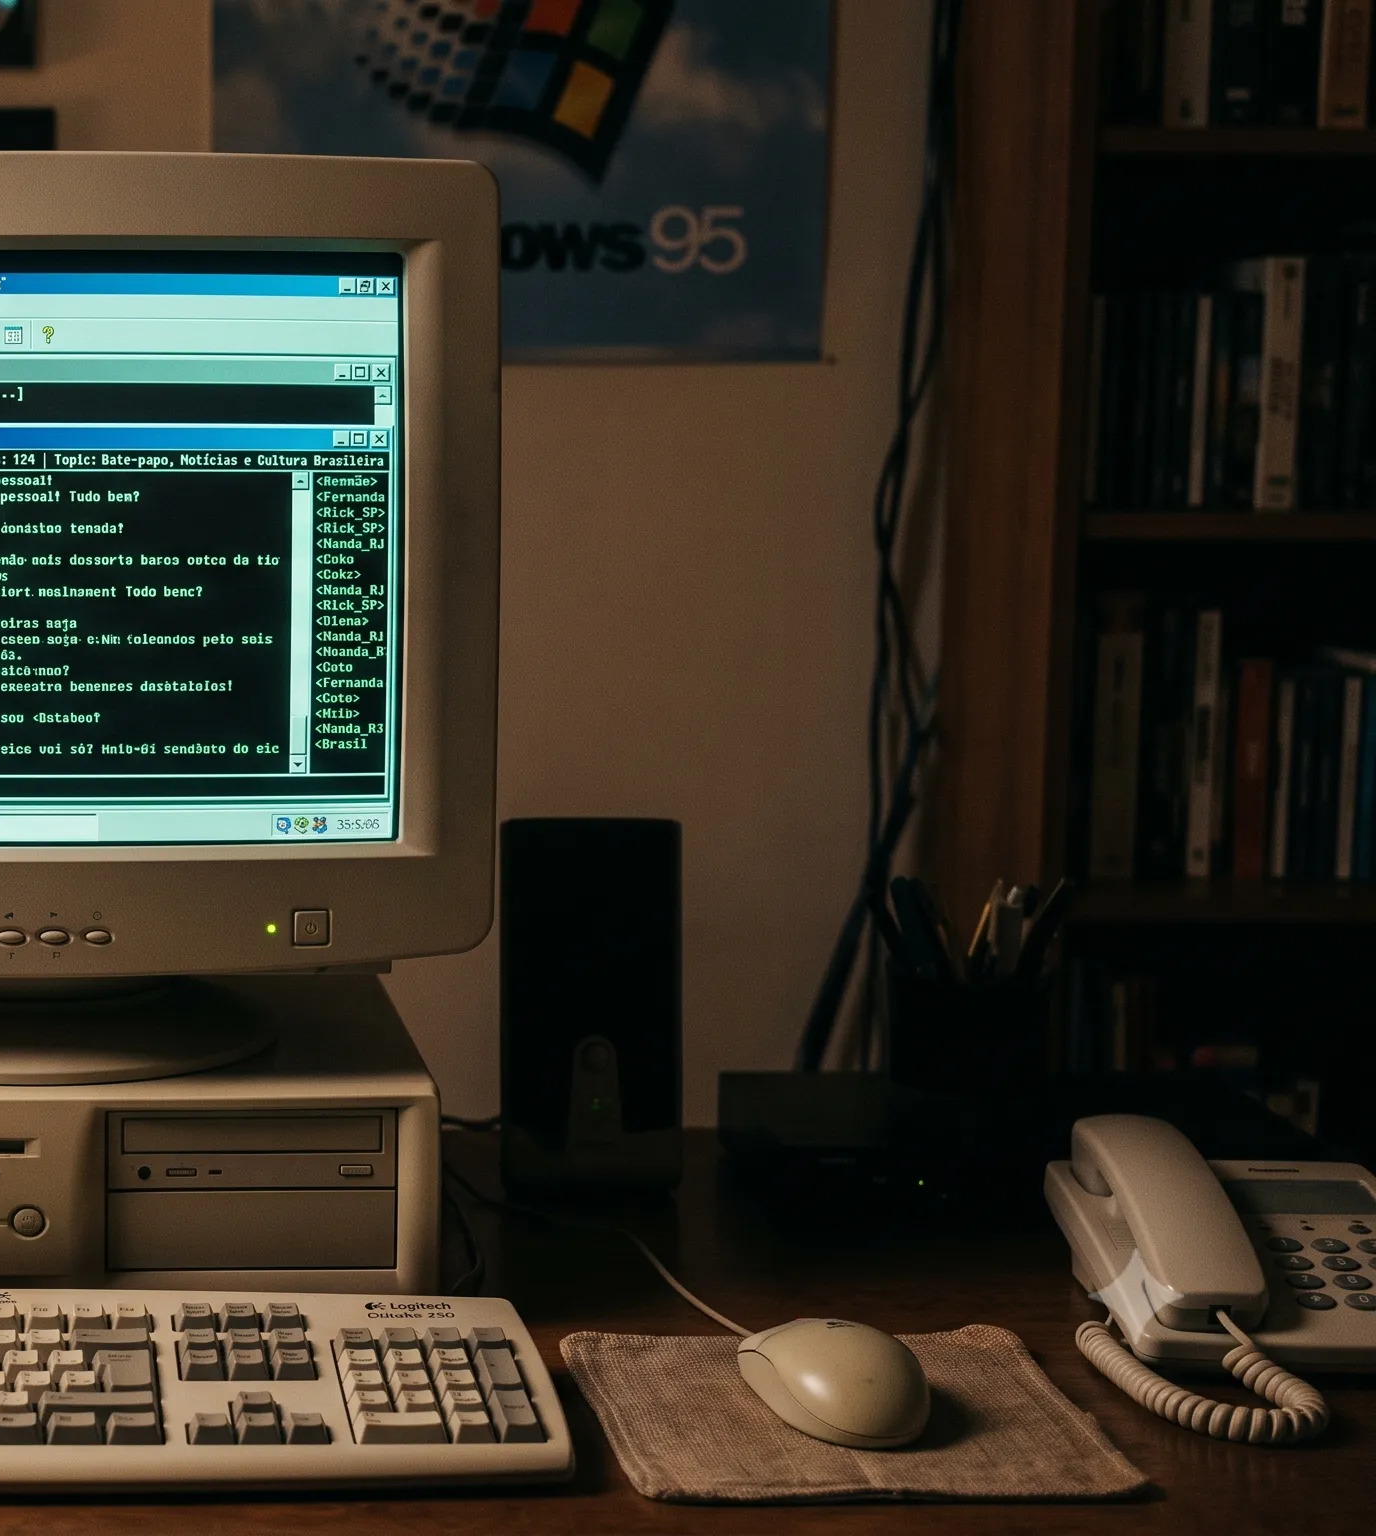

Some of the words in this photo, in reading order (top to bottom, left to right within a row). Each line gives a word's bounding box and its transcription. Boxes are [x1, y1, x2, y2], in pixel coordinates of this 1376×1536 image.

[649, 204, 748, 275] 95
[14, 454, 36, 466] 124
[54, 454, 96, 468] Topic:
[101, 454, 174, 468] Bate-papo,
[181, 453, 238, 466] Notícias
[244, 456, 252, 466] e
[257, 454, 308, 466] Cultura
[313, 455, 384, 467] Brasileira
[69, 491, 101, 502] Tudo
[316, 506, 385, 521] <Rick_SP>
[316, 522, 385, 536] <Rick_SP>
[316, 538, 384, 552] <Nanda_RJ
[233, 554, 250, 566] da
[125, 586, 157, 598] Todo
[316, 584, 384, 599] <Nanda_RJ
[316, 677, 384, 688] <Fernanda
[233, 743, 249, 754] do
[314, 738, 368, 750] <Brasil
[389, 1302, 452, 1312] Logitech
